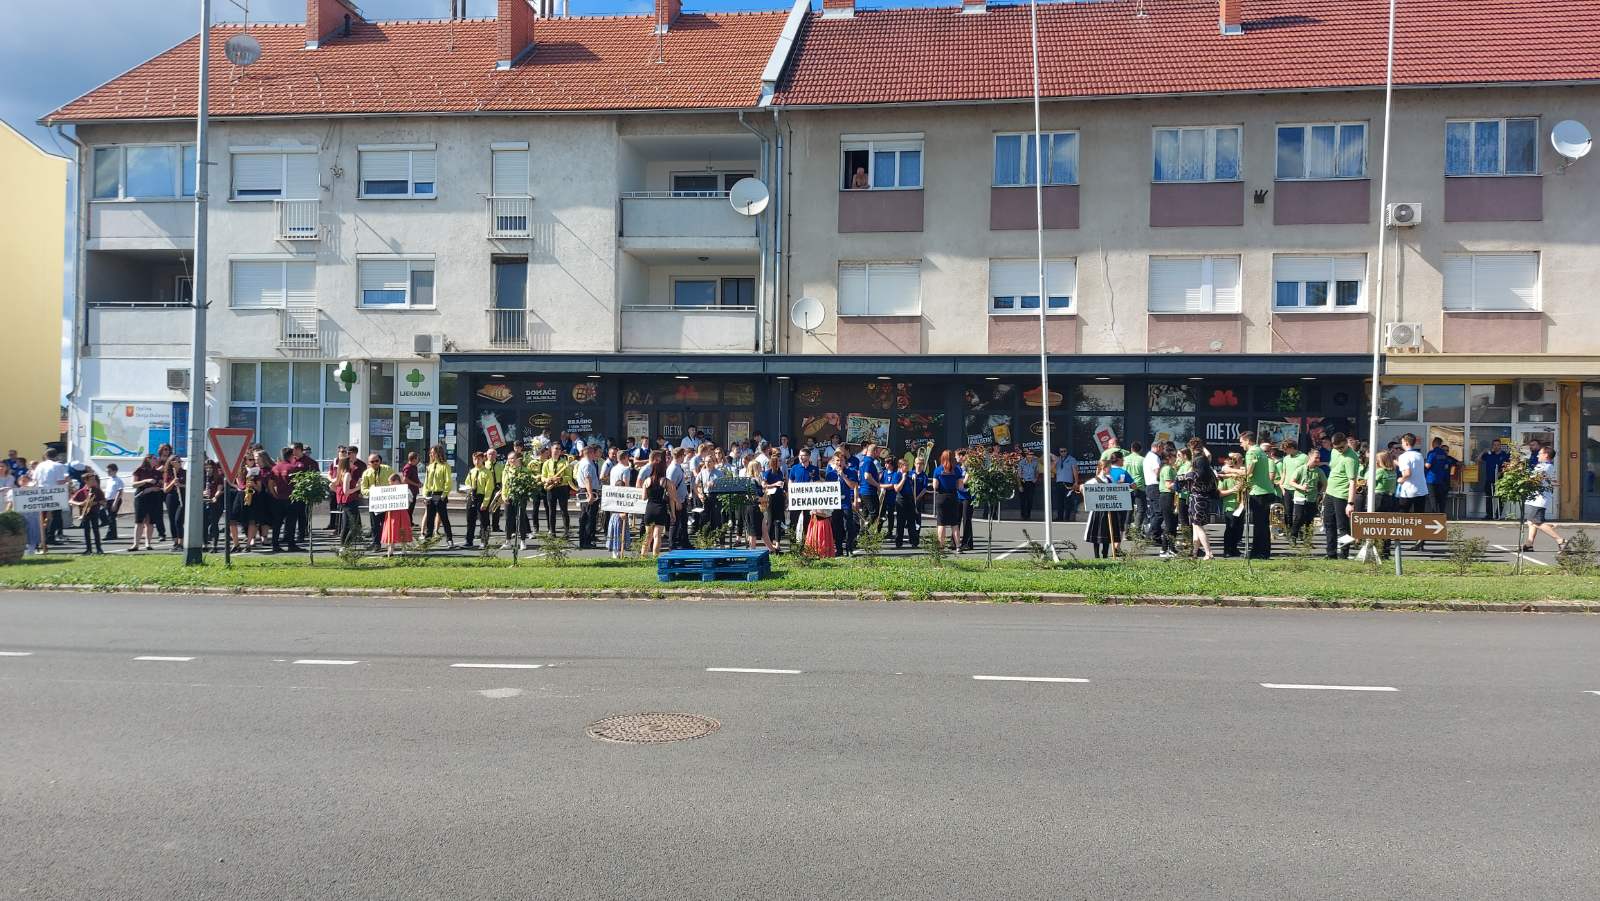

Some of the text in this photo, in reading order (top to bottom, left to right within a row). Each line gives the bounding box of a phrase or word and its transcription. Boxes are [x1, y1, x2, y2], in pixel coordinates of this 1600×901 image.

[1206, 422, 1241, 440] METSS
[790, 485, 839, 494] LIMENA GLAZBA
[605, 491, 625, 499] LIMENA
[791, 496, 839, 507] DEKANOVEC
[1353, 515, 1422, 527] Spomen obilježje
[1363, 527, 1413, 537] NOVI ZRIN
